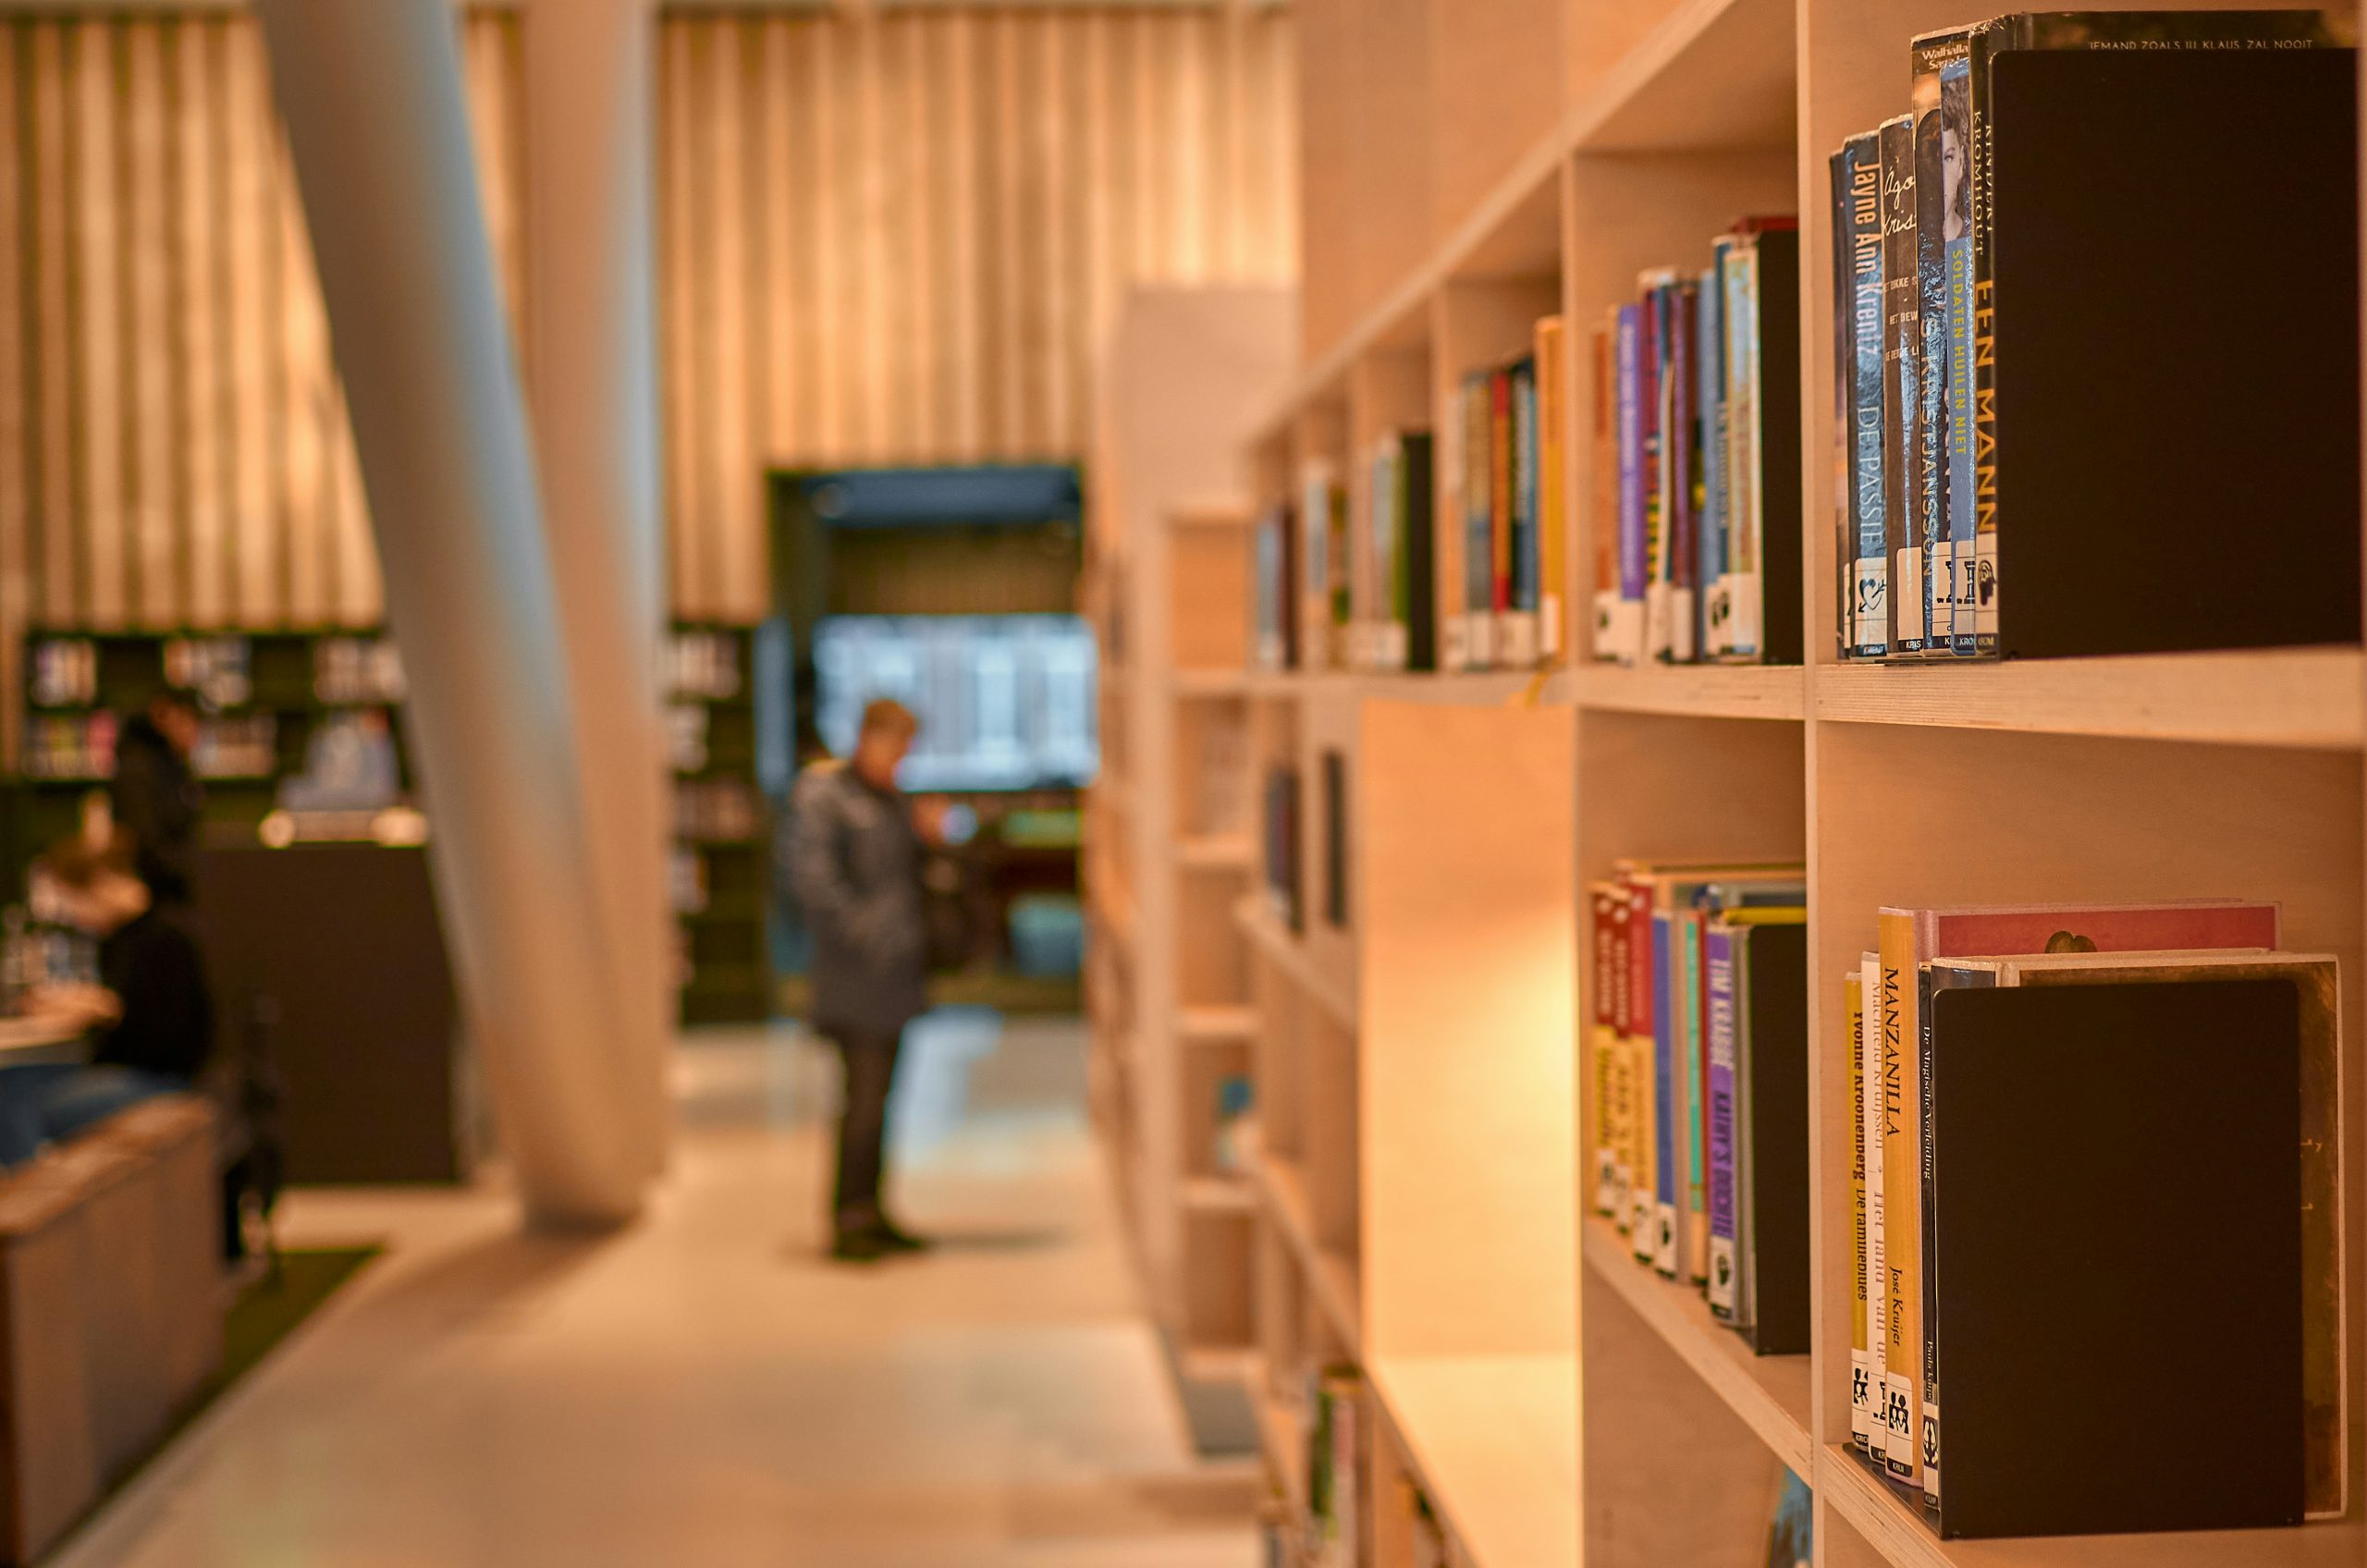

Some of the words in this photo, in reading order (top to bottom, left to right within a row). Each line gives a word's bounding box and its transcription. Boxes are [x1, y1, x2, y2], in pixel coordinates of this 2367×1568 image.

[1922, 43, 1968, 60] Walhalla
[2274, 39, 2312, 49] NOOIT
[1850, 161, 1881, 226] Jayne
[1884, 165, 1916, 210] Ágo
[1974, 110, 1982, 255] KROMHOUT
[1883, 210, 1917, 237] Kris
[1855, 232, 1883, 275] Ann
[1856, 282, 1883, 355] Krentz
[1952, 250, 1964, 338] SOLDATEN
[1975, 280, 1995, 367] EEN
[1954, 345, 1966, 410] HUILEN
[1858, 406, 1881, 448] DE
[1955, 417, 1967, 455] NIET
[1976, 388, 1997, 533] MANN
[1858, 457, 1883, 545] PASSIE
[1959, 637, 1974, 646] KRO
[1884, 967, 1900, 1137] MANZANILLA
[1923, 1026, 1931, 1045] De
[1922, 1048, 1932, 1109] Magische
[1923, 1112, 1932, 1180] Verleiding
[1889, 1266, 1903, 1294] José
[1892, 1297, 1903, 1347] Kruijer
